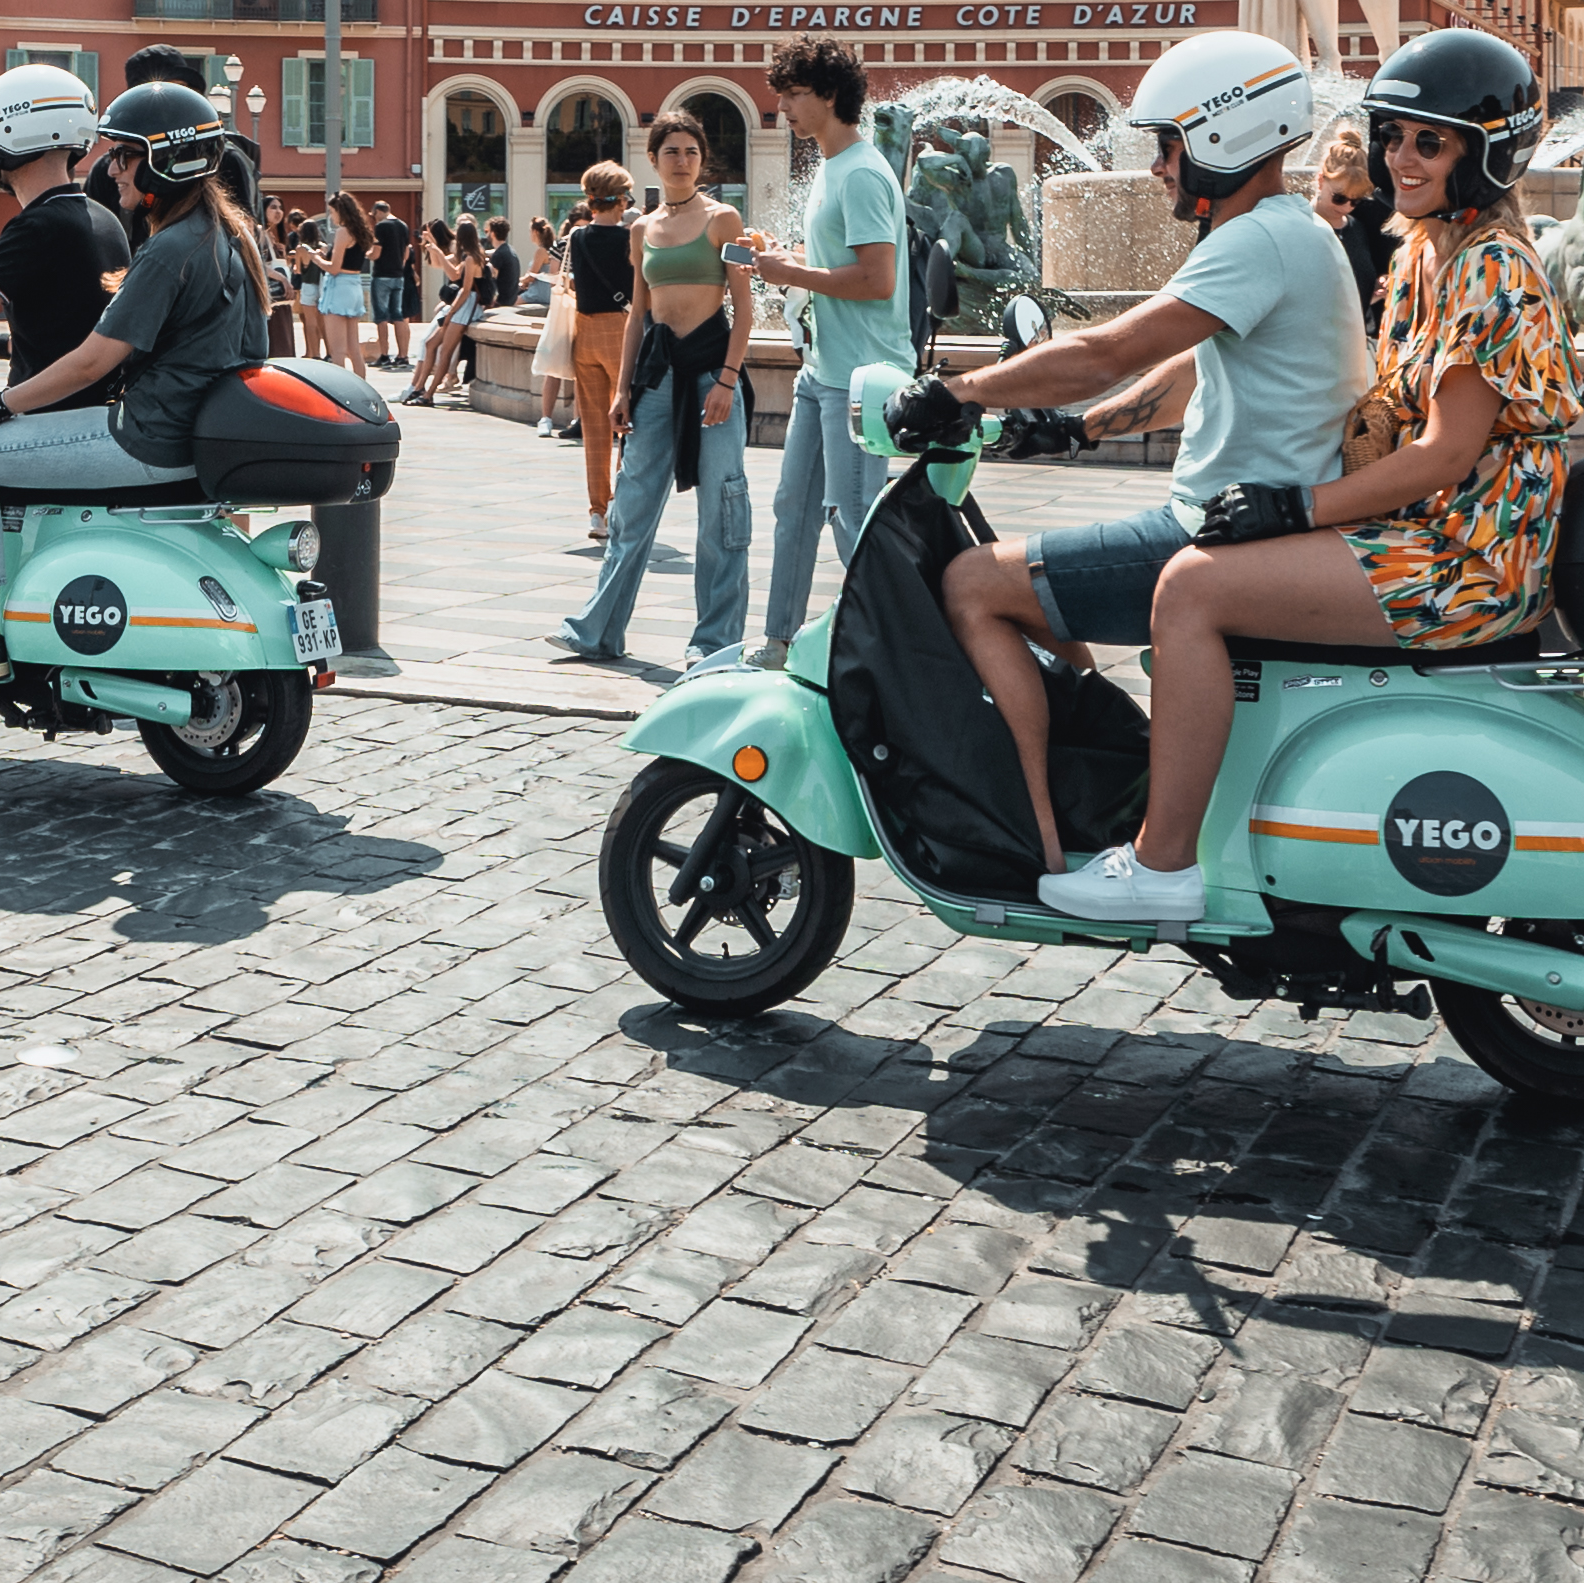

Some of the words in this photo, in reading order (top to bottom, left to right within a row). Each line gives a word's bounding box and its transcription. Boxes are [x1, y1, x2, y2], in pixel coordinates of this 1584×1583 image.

[584, 5, 702, 27] CAISSE
[731, 6, 923, 27] D'EPARGNE
[956, 5, 1042, 26] COTE
[1073, 4, 1196, 25] D'AZUR
[1, 101, 30, 115] YEGO
[1201, 86, 1244, 113] YEGO
[1507, 107, 1535, 128] YEGO
[167, 126, 196, 139] YEGO
[59, 605, 121, 626] YEGO
[1394, 818, 1501, 850] YEGO
